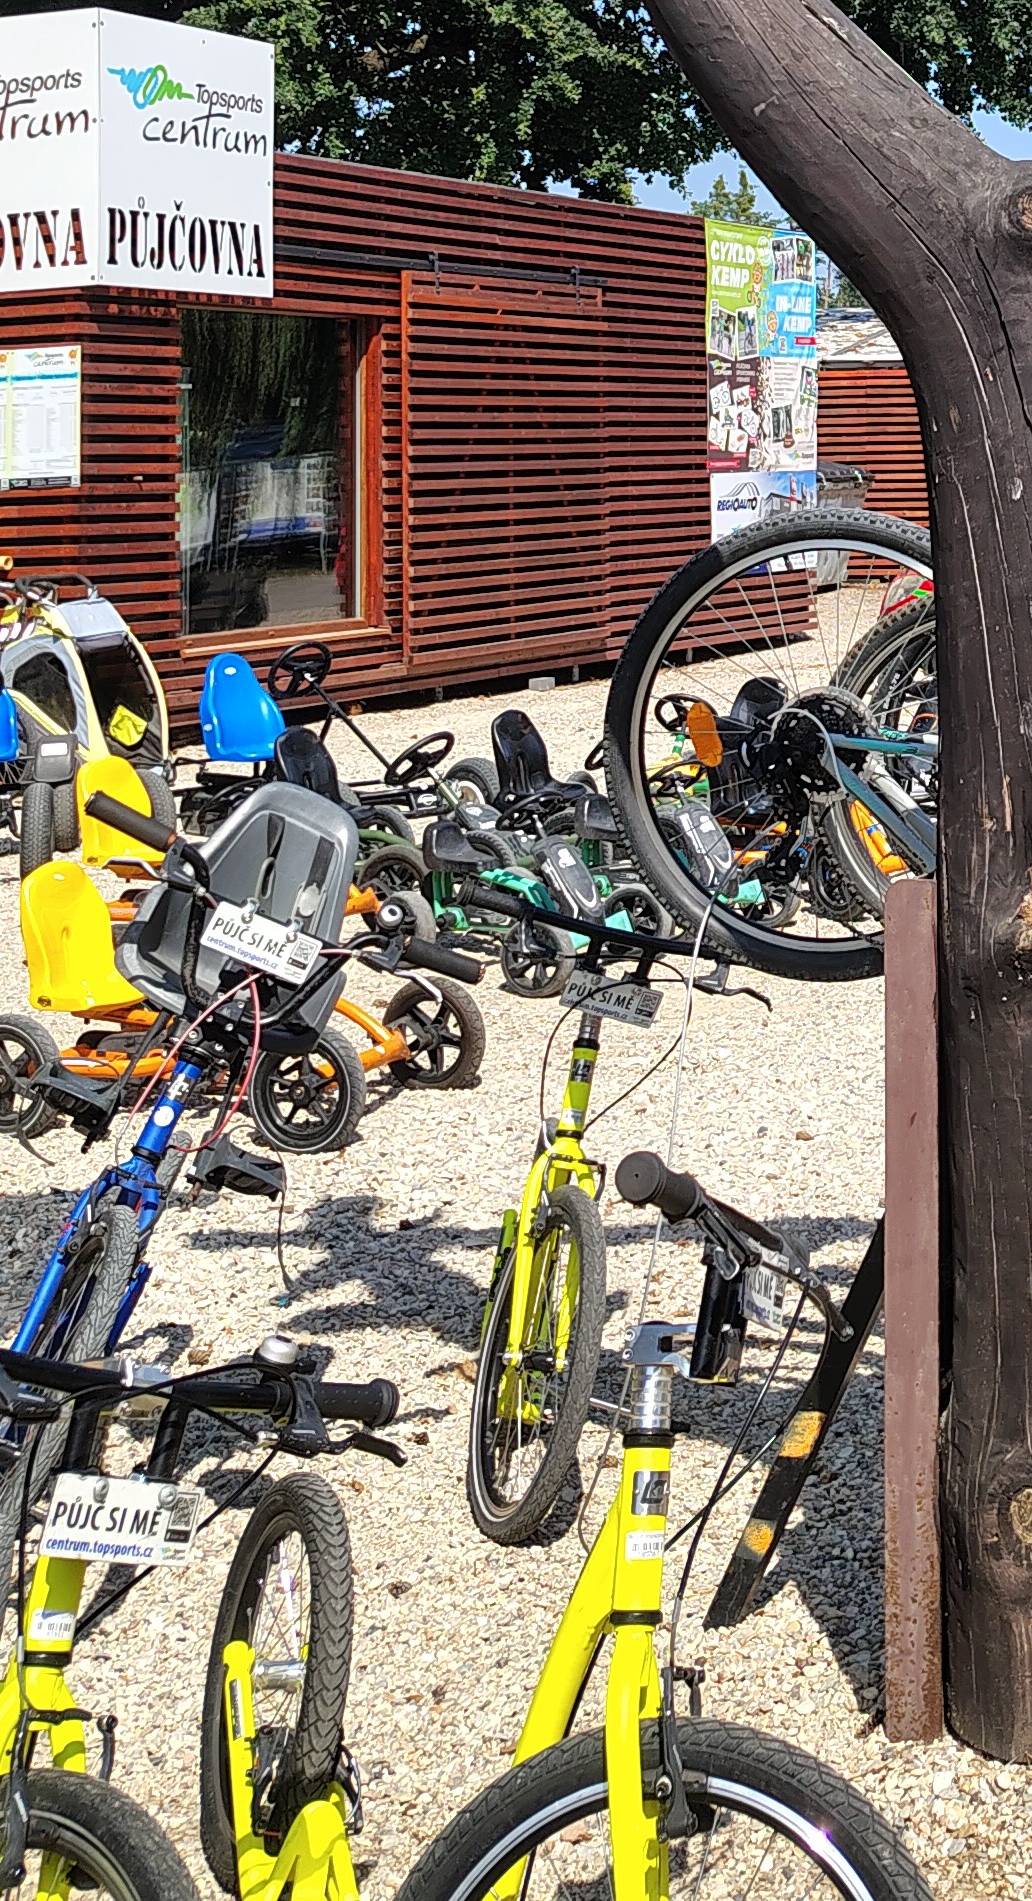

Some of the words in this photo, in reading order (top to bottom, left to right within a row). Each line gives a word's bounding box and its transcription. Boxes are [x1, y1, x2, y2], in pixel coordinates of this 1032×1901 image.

[194, 82, 264, 114] Topsports
[106, 195, 266, 279] PŮJČOVNA
[709, 239, 756, 265] CYKLO
[710, 264, 750, 289] KEMP
[782, 315, 813, 333] KEMP
[212, 916, 252, 943] PŮJČ
[247, 932, 265, 949] SI
[264, 939, 289, 959] MĚ
[599, 990, 614, 1005] SI
[613, 993, 635, 1011] MĚ
[105, 1505, 129, 1533] SI
[45, 1537, 154, 1559] centrum.topsports.cz
